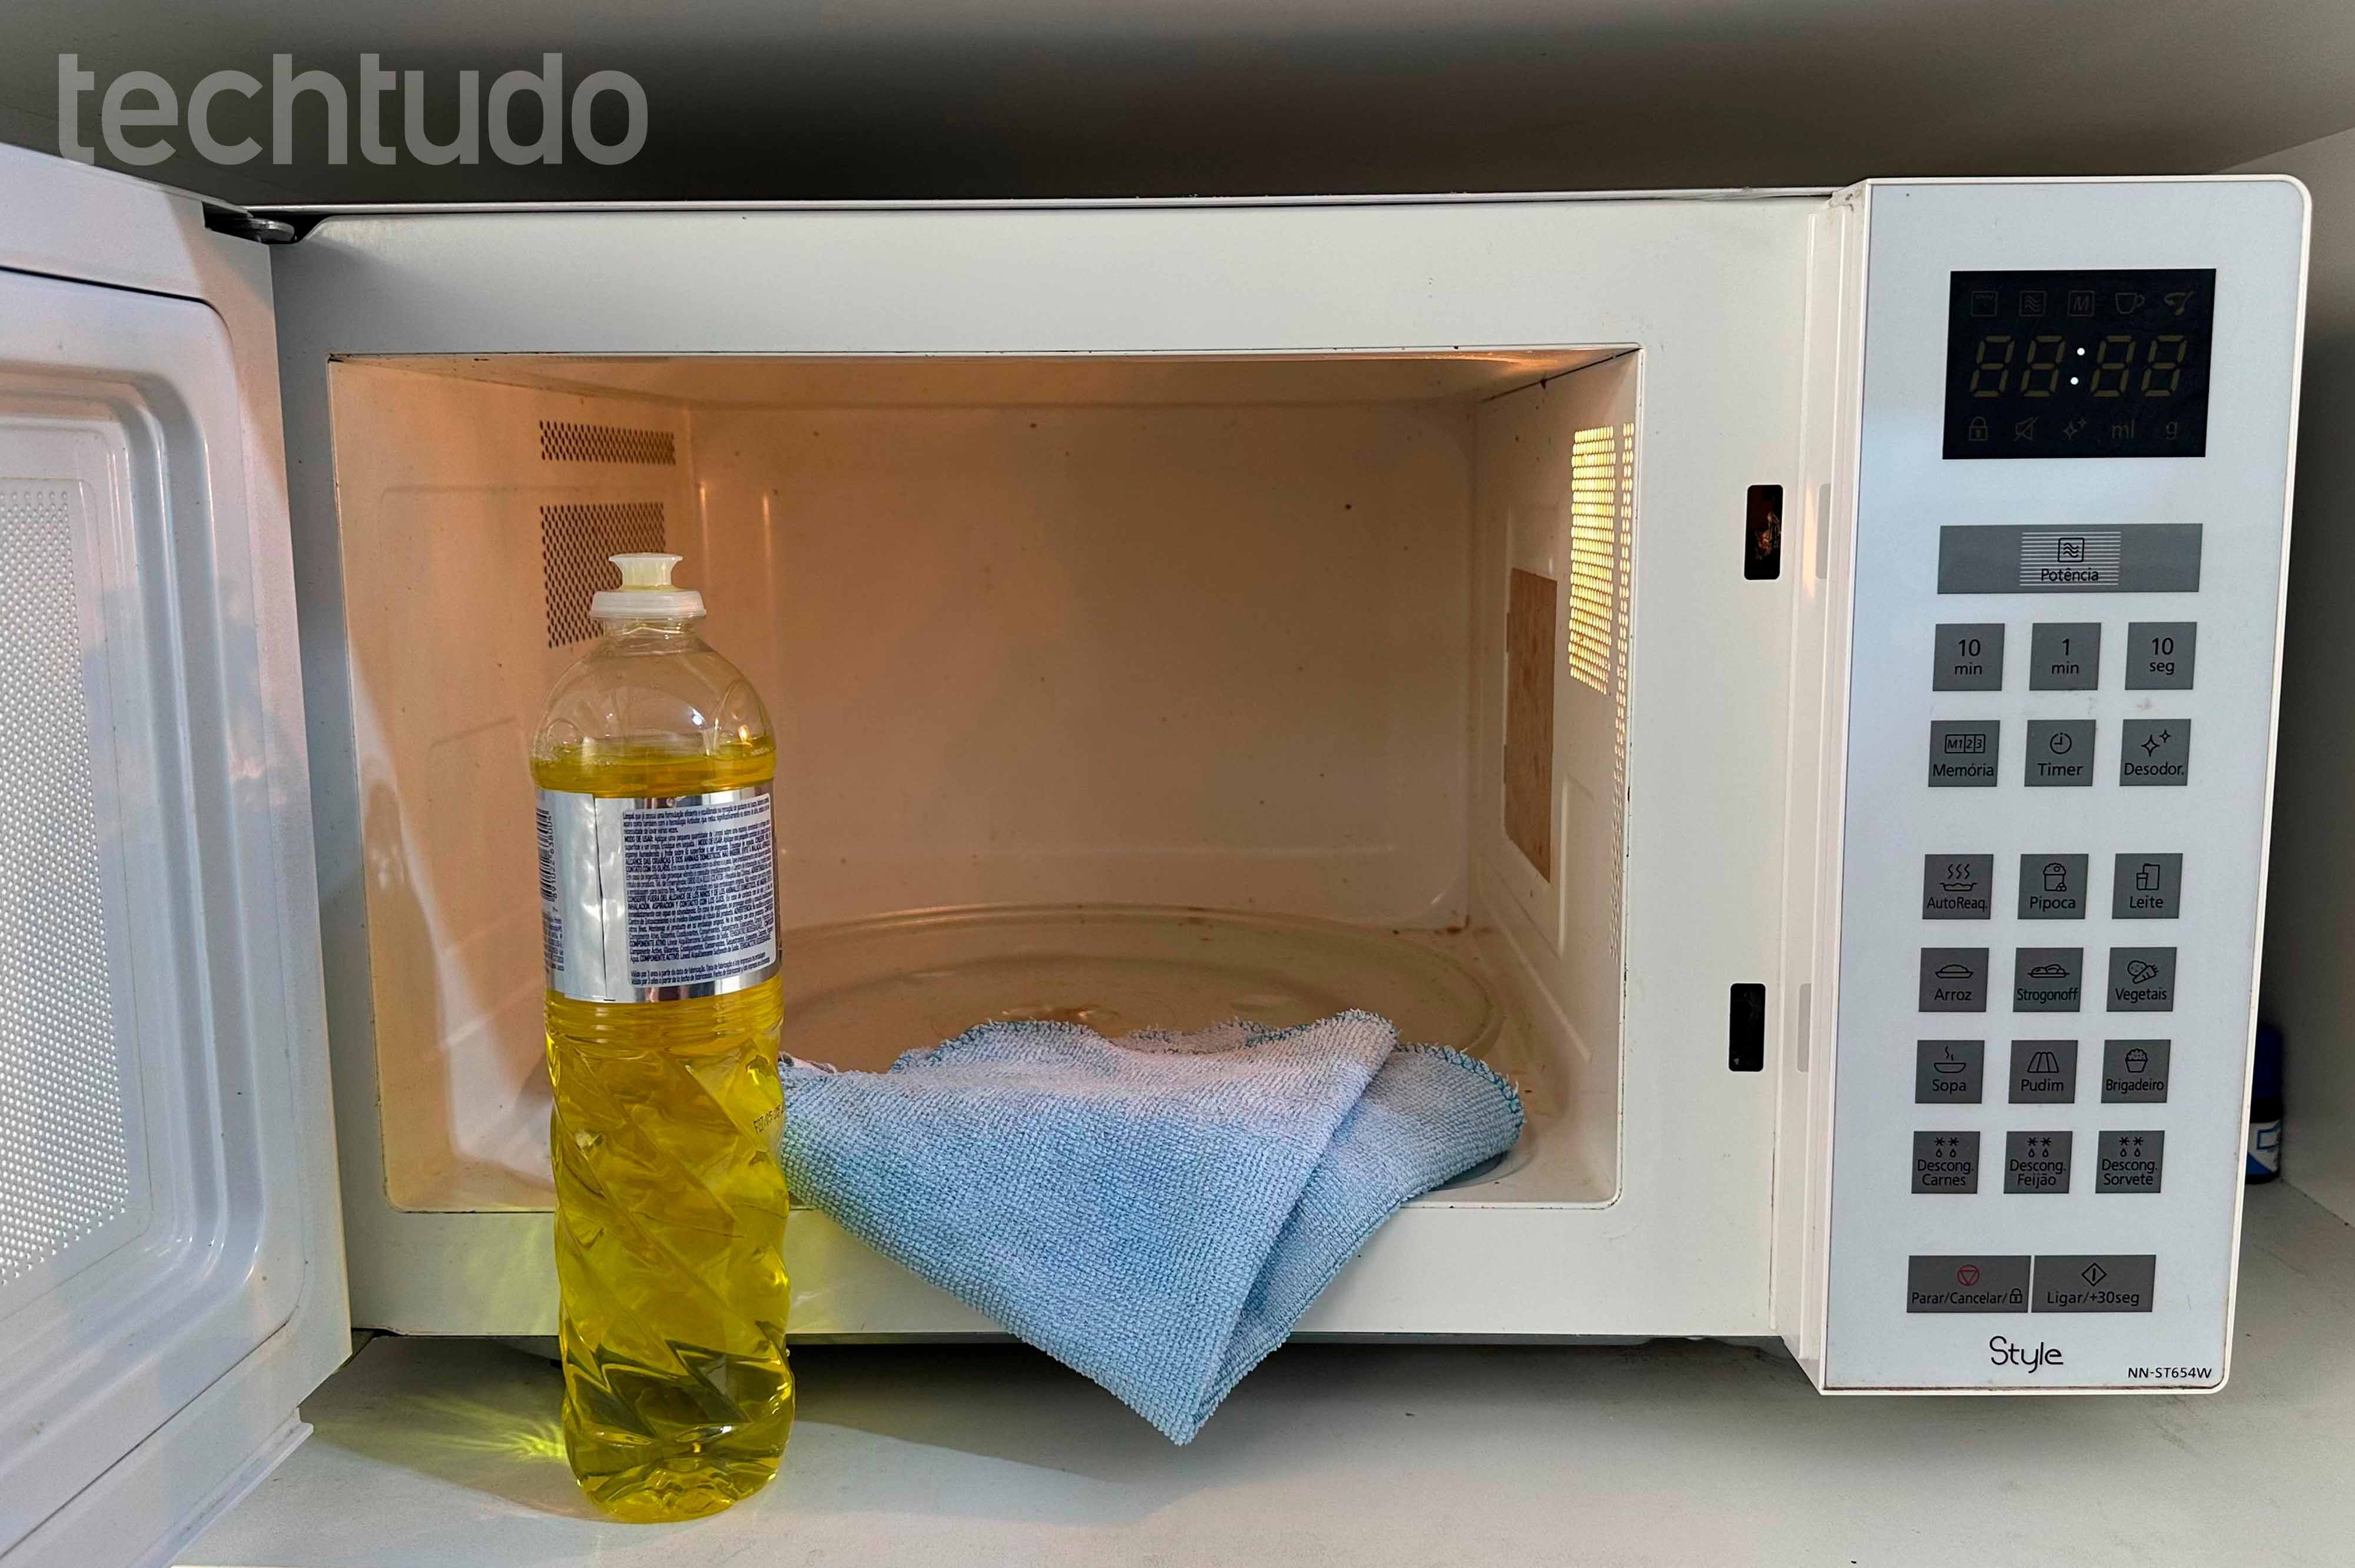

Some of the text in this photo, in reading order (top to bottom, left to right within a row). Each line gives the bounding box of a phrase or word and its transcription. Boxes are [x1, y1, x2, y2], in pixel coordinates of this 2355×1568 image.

[2111, 420, 2134, 439] ml
[2041, 568, 2099, 582] Potência
[1958, 639, 1981, 657] 10
[2062, 638, 2071, 656] 1
[2152, 637, 2174, 655] 10
[1954, 662, 1982, 675] min
[2051, 661, 2079, 674] min
[2149, 660, 2175, 675] seg
[1932, 762, 1994, 777] Memória
[2038, 763, 2083, 777] Timer
[2124, 762, 2185, 776] Desodor.
[1926, 896, 1988, 912] AutoReaq.
[2029, 896, 2076, 912] Pipoca
[2130, 895, 2164, 909] Leite
[1934, 989, 1972, 1001] Arroz
[2016, 987, 2078, 1004] Strogonoff
[2115, 987, 2167, 1004] Vegetais
[1932, 1079, 1967, 1095] Sopa
[2021, 1078, 2064, 1092] Pudim
[2105, 1078, 2164, 1094] Brigadeiro
[1917, 1159, 1974, 1174] Descong.
[2009, 1159, 2067, 1174] Descong.
[2101, 1158, 2158, 1174] Descong.
[1922, 1173, 1966, 1187] Carnes
[2017, 1172, 2057, 1190] Feijão
[2103, 1173, 2153, 1186] Sorvete
[2046, 1290, 2140, 1307] Ligar/+30seg
[1989, 1335, 2064, 1373] Style
[2127, 1367, 2213, 1378] NN-ST654W
